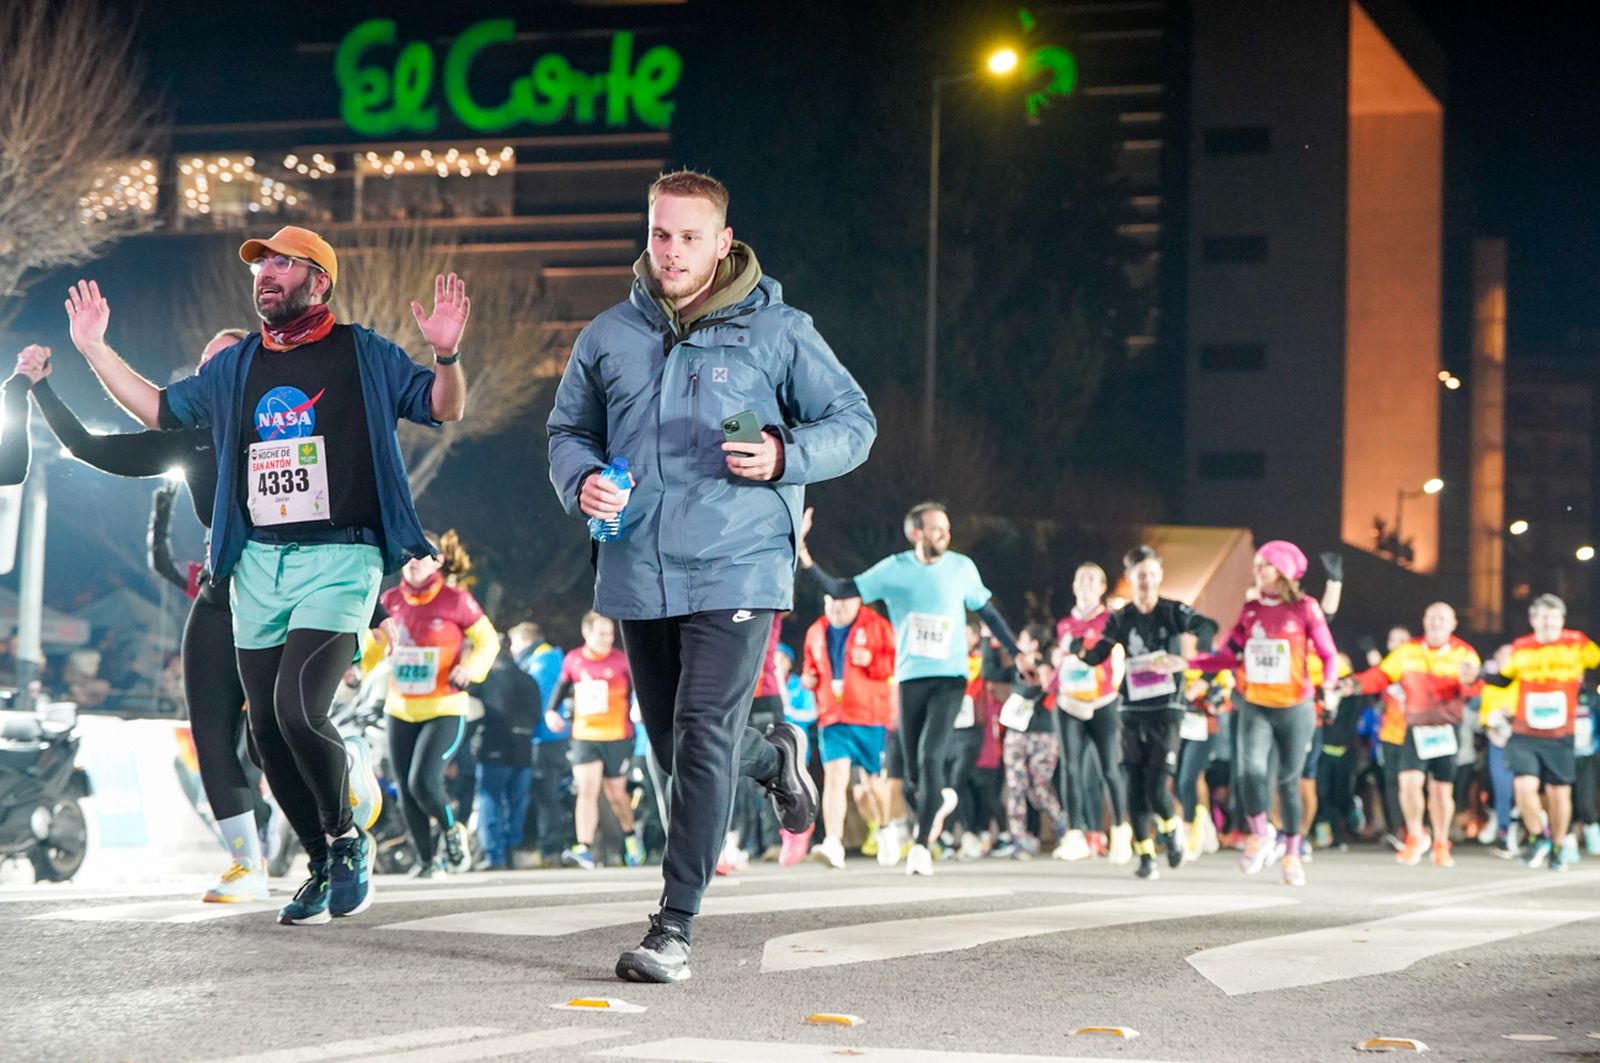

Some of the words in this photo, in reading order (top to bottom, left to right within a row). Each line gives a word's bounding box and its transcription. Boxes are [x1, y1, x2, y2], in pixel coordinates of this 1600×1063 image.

[335, 19, 437, 135] El
[444, 19, 682, 131] Corte
[258, 411, 312, 428] NASA
[258, 450, 280, 460] NOCHE
[281, 449, 291, 457] DE
[252, 462, 265, 472] SAN
[258, 468, 310, 496] 4333
